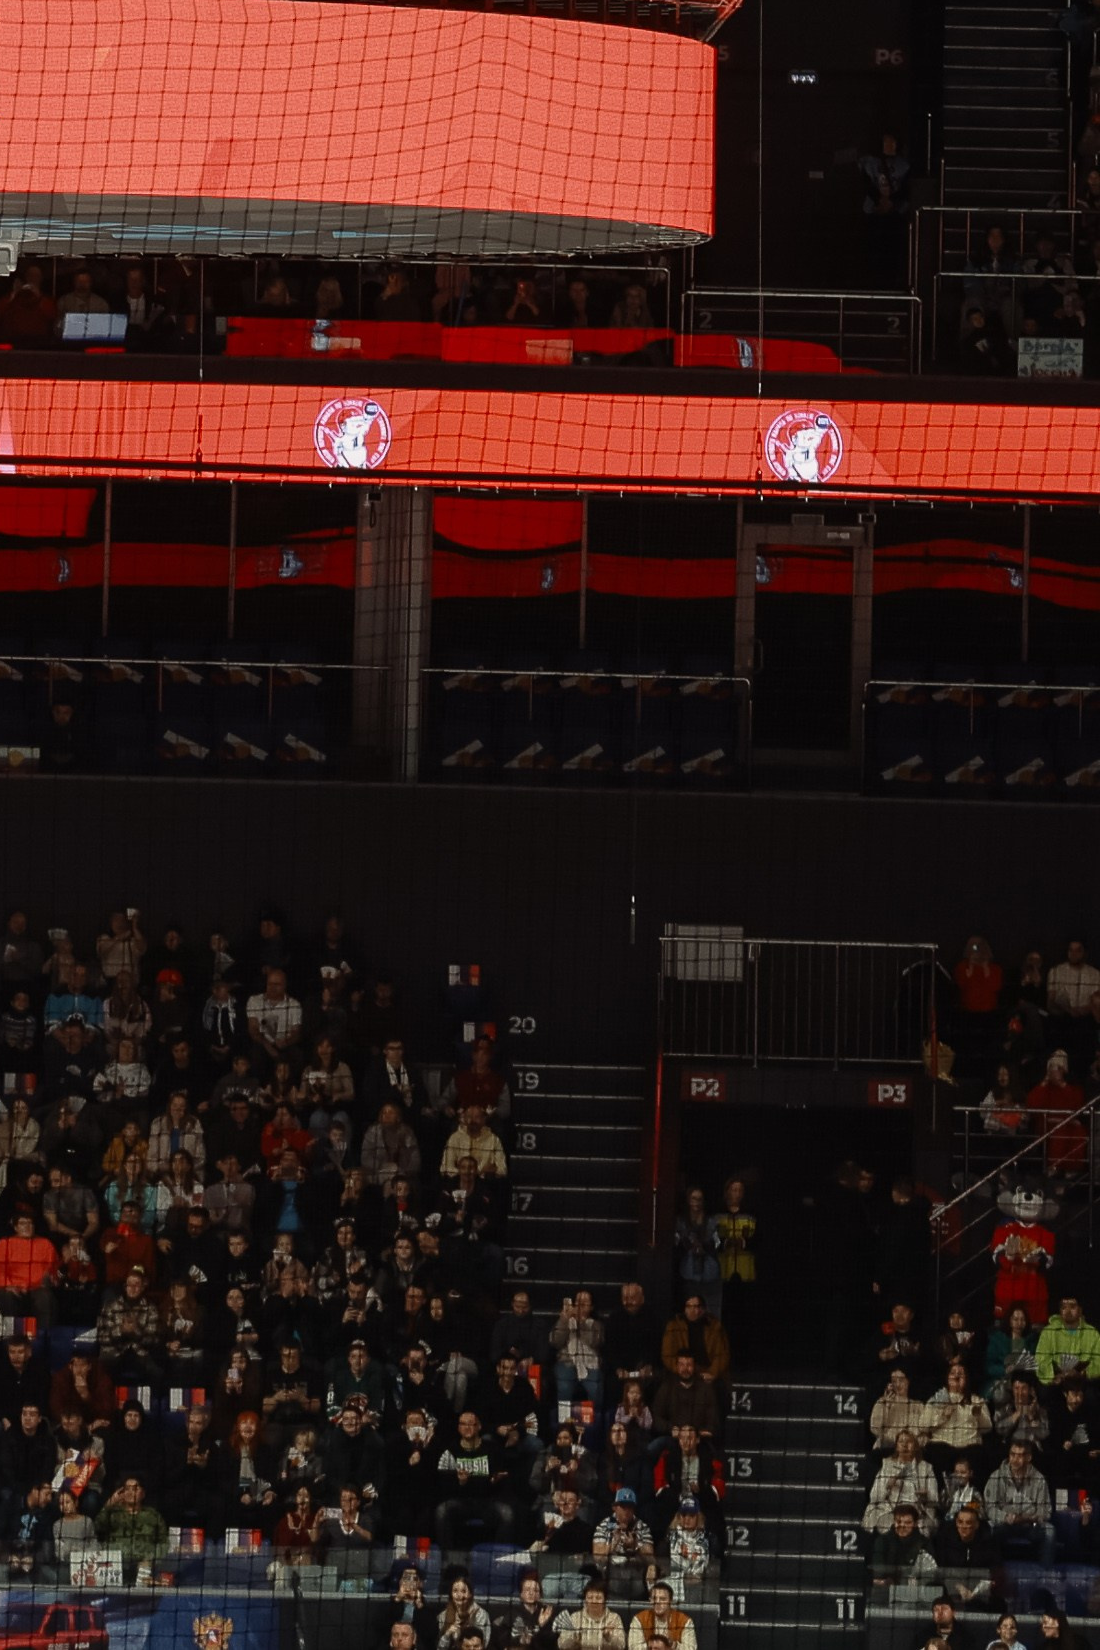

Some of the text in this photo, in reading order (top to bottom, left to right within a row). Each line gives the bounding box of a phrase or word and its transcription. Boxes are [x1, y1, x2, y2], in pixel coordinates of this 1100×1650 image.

[700, 312, 712, 328] 2
[887, 316, 900, 333] 2
[509, 1016, 536, 1034] 20
[517, 1071, 539, 1090] 19
[516, 1132, 537, 1150] 18
[511, 1193, 533, 1211] 17
[505, 1256, 529, 1276] 16
[731, 1391, 751, 1411] 14
[834, 1394, 858, 1414] 14
[728, 1457, 753, 1477] 13
[834, 1461, 859, 1481] 13
[726, 1526, 750, 1546] 12
[833, 1529, 858, 1550] 12
[726, 1595, 746, 1616] 11
[836, 1598, 855, 1619] 11
